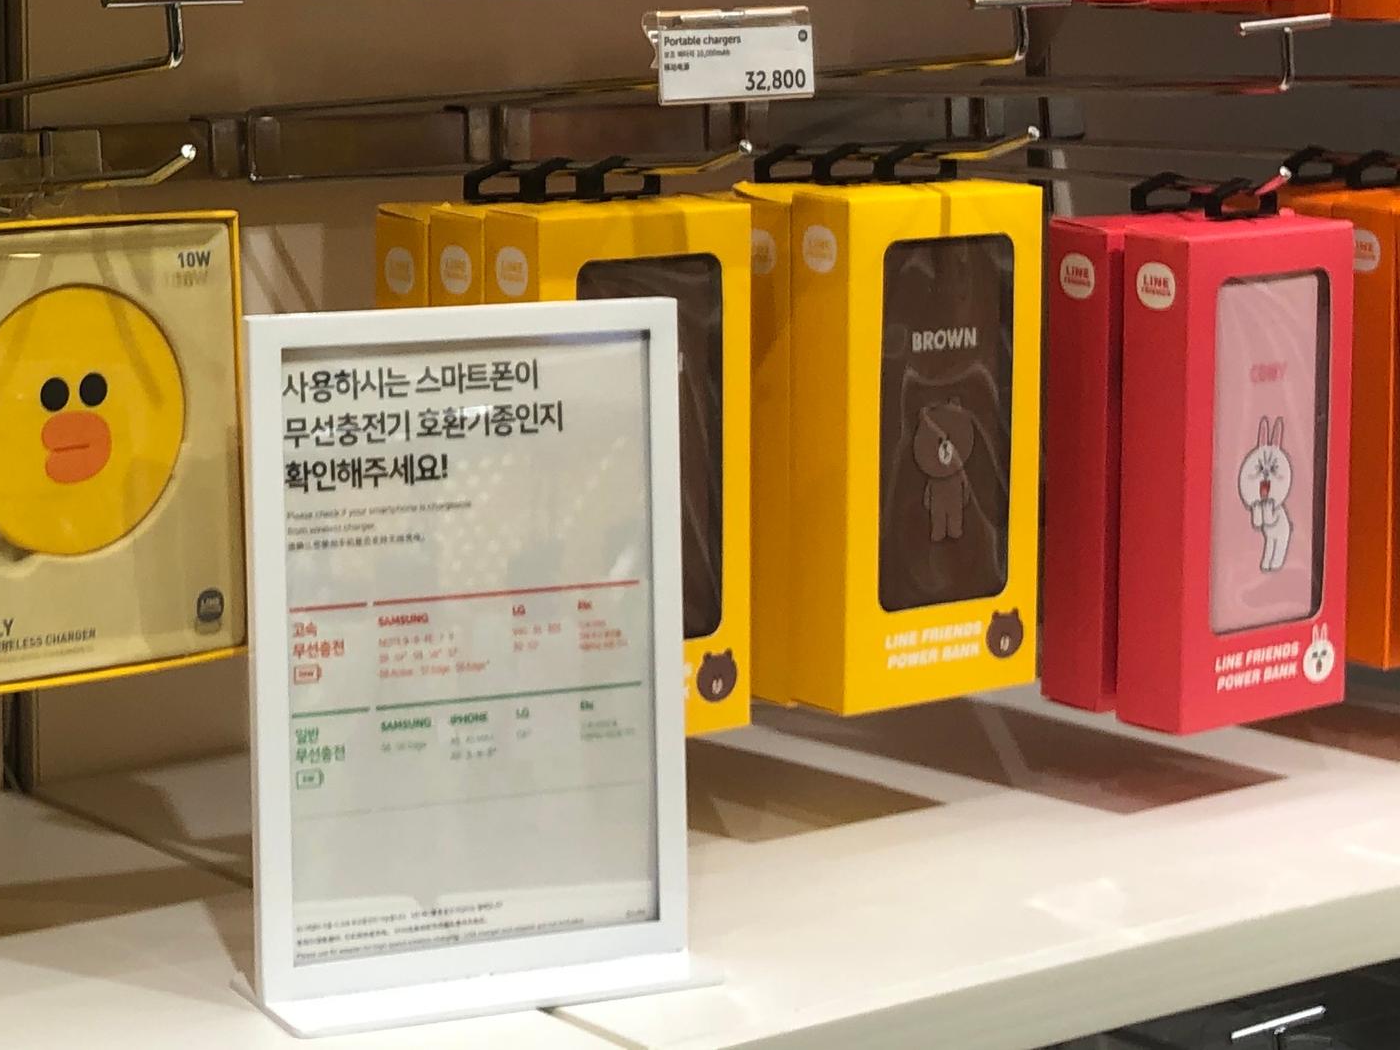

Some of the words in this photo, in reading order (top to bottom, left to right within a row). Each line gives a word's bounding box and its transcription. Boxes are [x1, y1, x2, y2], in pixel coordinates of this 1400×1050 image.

[664, 35, 701, 47] Portable
[703, 34, 741, 46] chargers
[745, 68, 806, 92] 32,800
[177, 251, 211, 268] 10W
[1066, 264, 1089, 280] LINE
[1143, 274, 1170, 289] LINE
[912, 327, 977, 353] BROWN
[282, 366, 411, 404] 사용하시는
[415, 358, 539, 395] 스마트폰이
[283, 409, 411, 448] 무선충전기
[416, 400, 564, 439] 호환기종인지
[284, 453, 449, 493] 확인해주세요!
[378, 612, 429, 628] SAMSUNG
[512, 604, 526, 616] LG
[45, 628, 97, 647] CHARGER
[885, 631, 919, 650] LINE
[922, 621, 983, 646] FRIENDS
[293, 638, 345, 659] 무선충전
[887, 649, 939, 669] POWER
[943, 643, 981, 664] BANK
[1215, 653, 1242, 673] LINE
[1245, 641, 1300, 667] FRIENDS
[1217, 672, 1263, 692] POWER
[1265, 663, 1298, 685] BANK
[381, 716, 432, 733] SAMSUNG
[450, 711, 488, 726] IPHONE
[515, 707, 530, 719] LG
[296, 744, 346, 764] 무선충전
